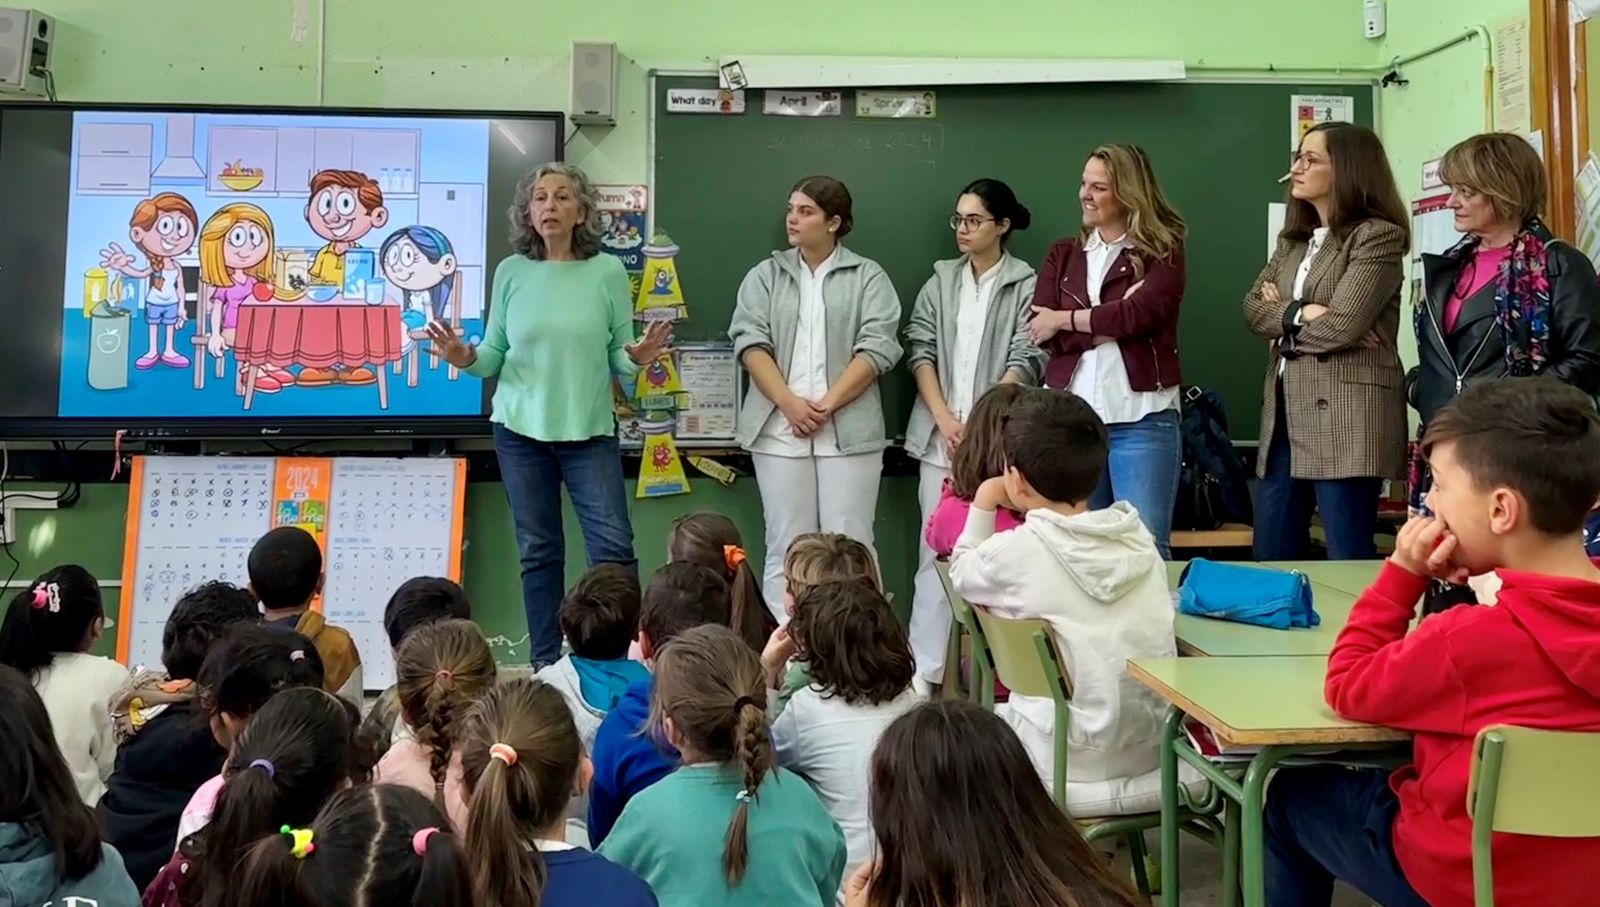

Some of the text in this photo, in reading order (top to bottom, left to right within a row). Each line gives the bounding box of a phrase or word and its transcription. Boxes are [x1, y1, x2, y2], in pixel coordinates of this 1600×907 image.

[671, 96, 717, 106] What day
[779, 95, 807, 108] April
[599, 193, 626, 203] tumn
[645, 398, 672, 407] LUNES
[286, 467, 319, 490] 2024
